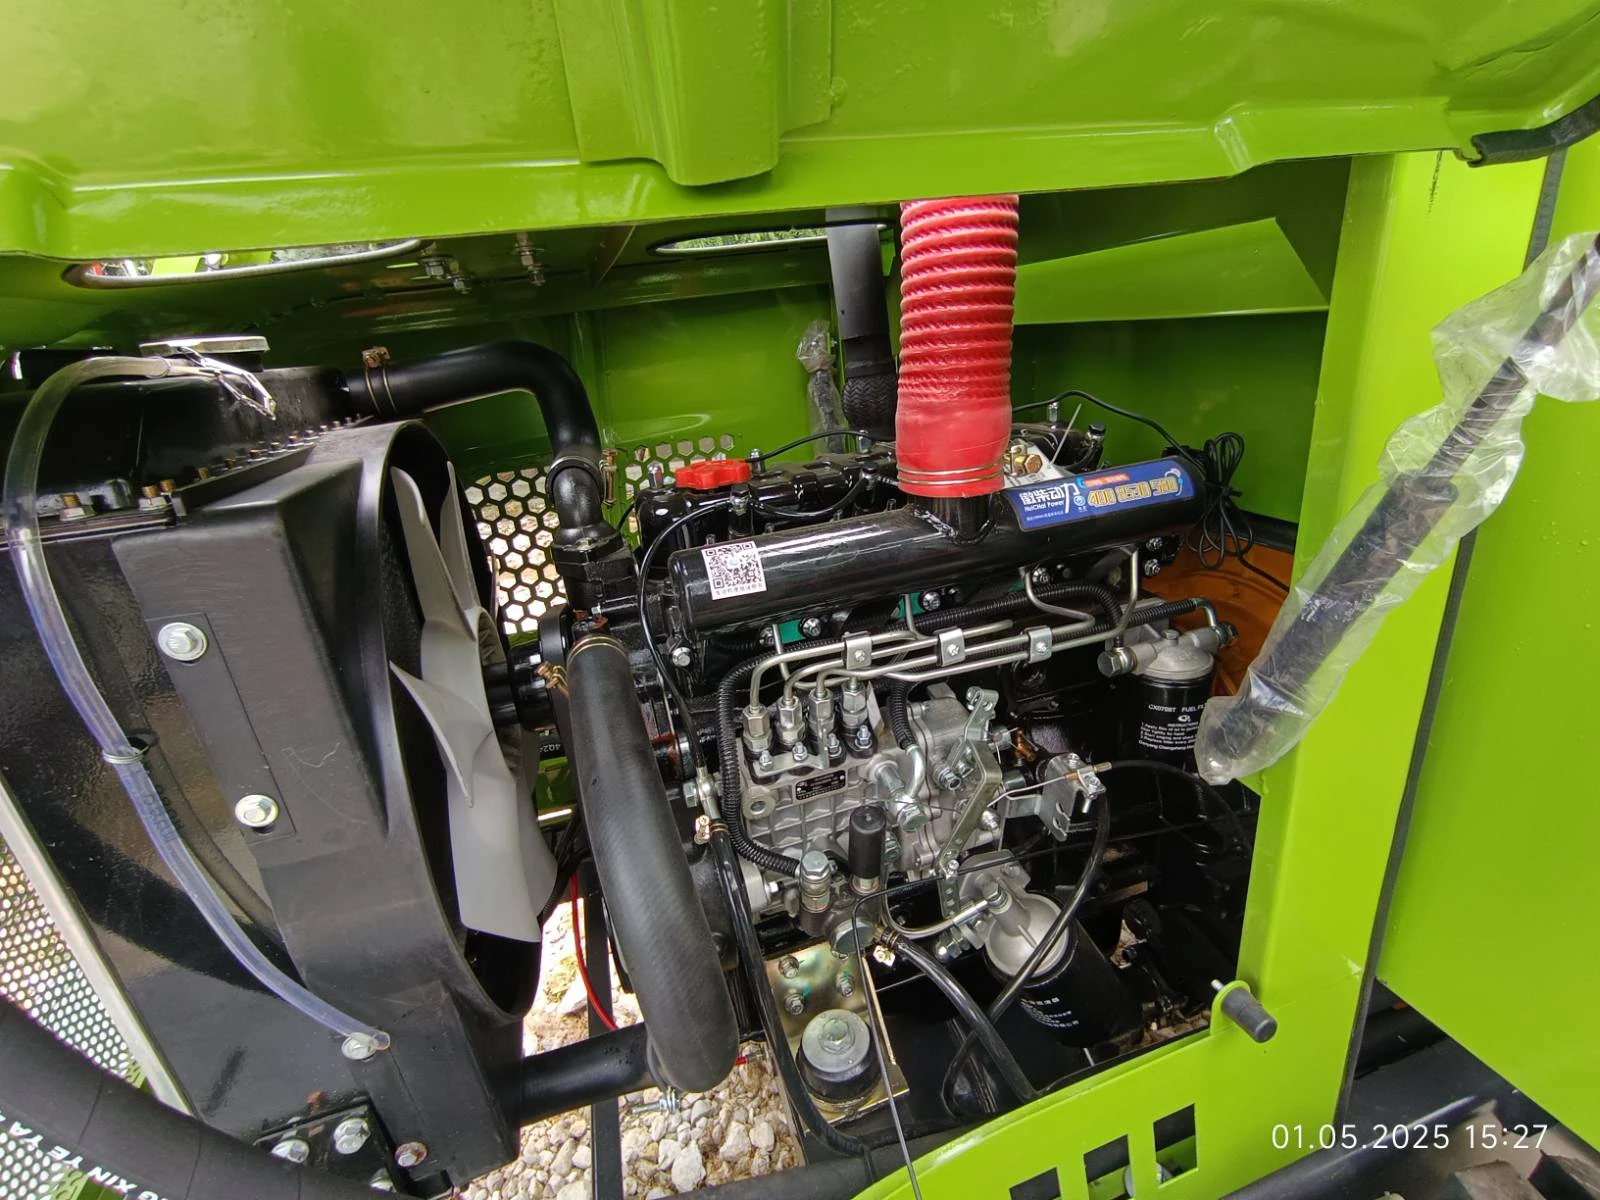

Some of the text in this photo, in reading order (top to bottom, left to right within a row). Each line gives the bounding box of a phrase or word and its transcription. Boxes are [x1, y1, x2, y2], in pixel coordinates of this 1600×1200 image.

[9, 1121, 43, 1148] YA
[47, 1145, 83, 1169] YE
[87, 1166, 138, 1193] XIN
